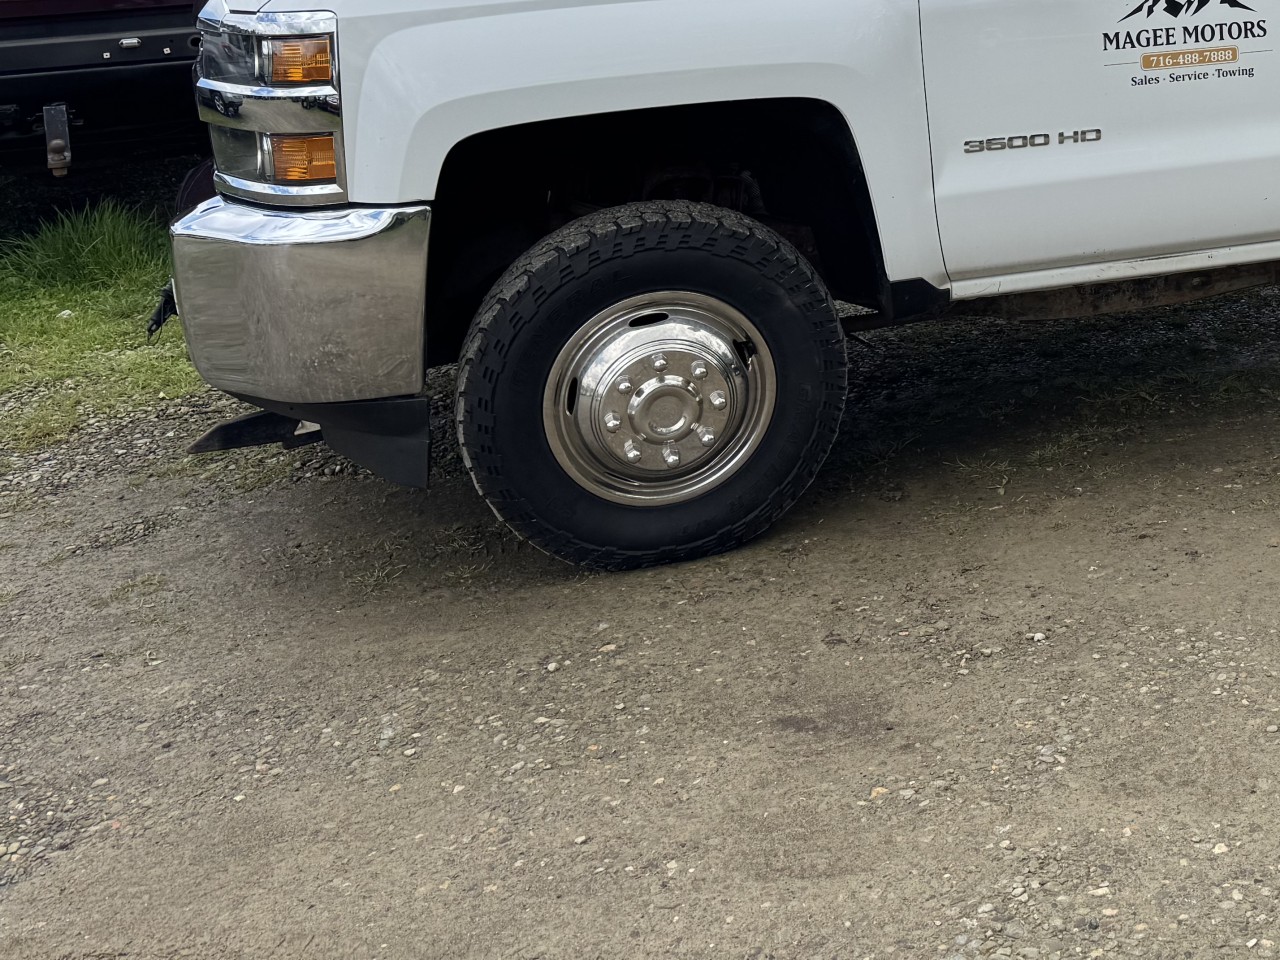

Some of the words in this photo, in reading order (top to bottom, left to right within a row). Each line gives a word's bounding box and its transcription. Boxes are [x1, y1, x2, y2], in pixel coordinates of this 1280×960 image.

[1102, 27, 1176, 50] MAGEE
[1182, 19, 1267, 43] MOTORS
[1150, 49, 1233, 67] 716-488-7888
[1131, 74, 1160, 87] Sales
[1168, 69, 1209, 83] Service
[1215, 66, 1255, 79] Towing
[963, 133, 1050, 154] 3500
[1058, 128, 1102, 145] HD
